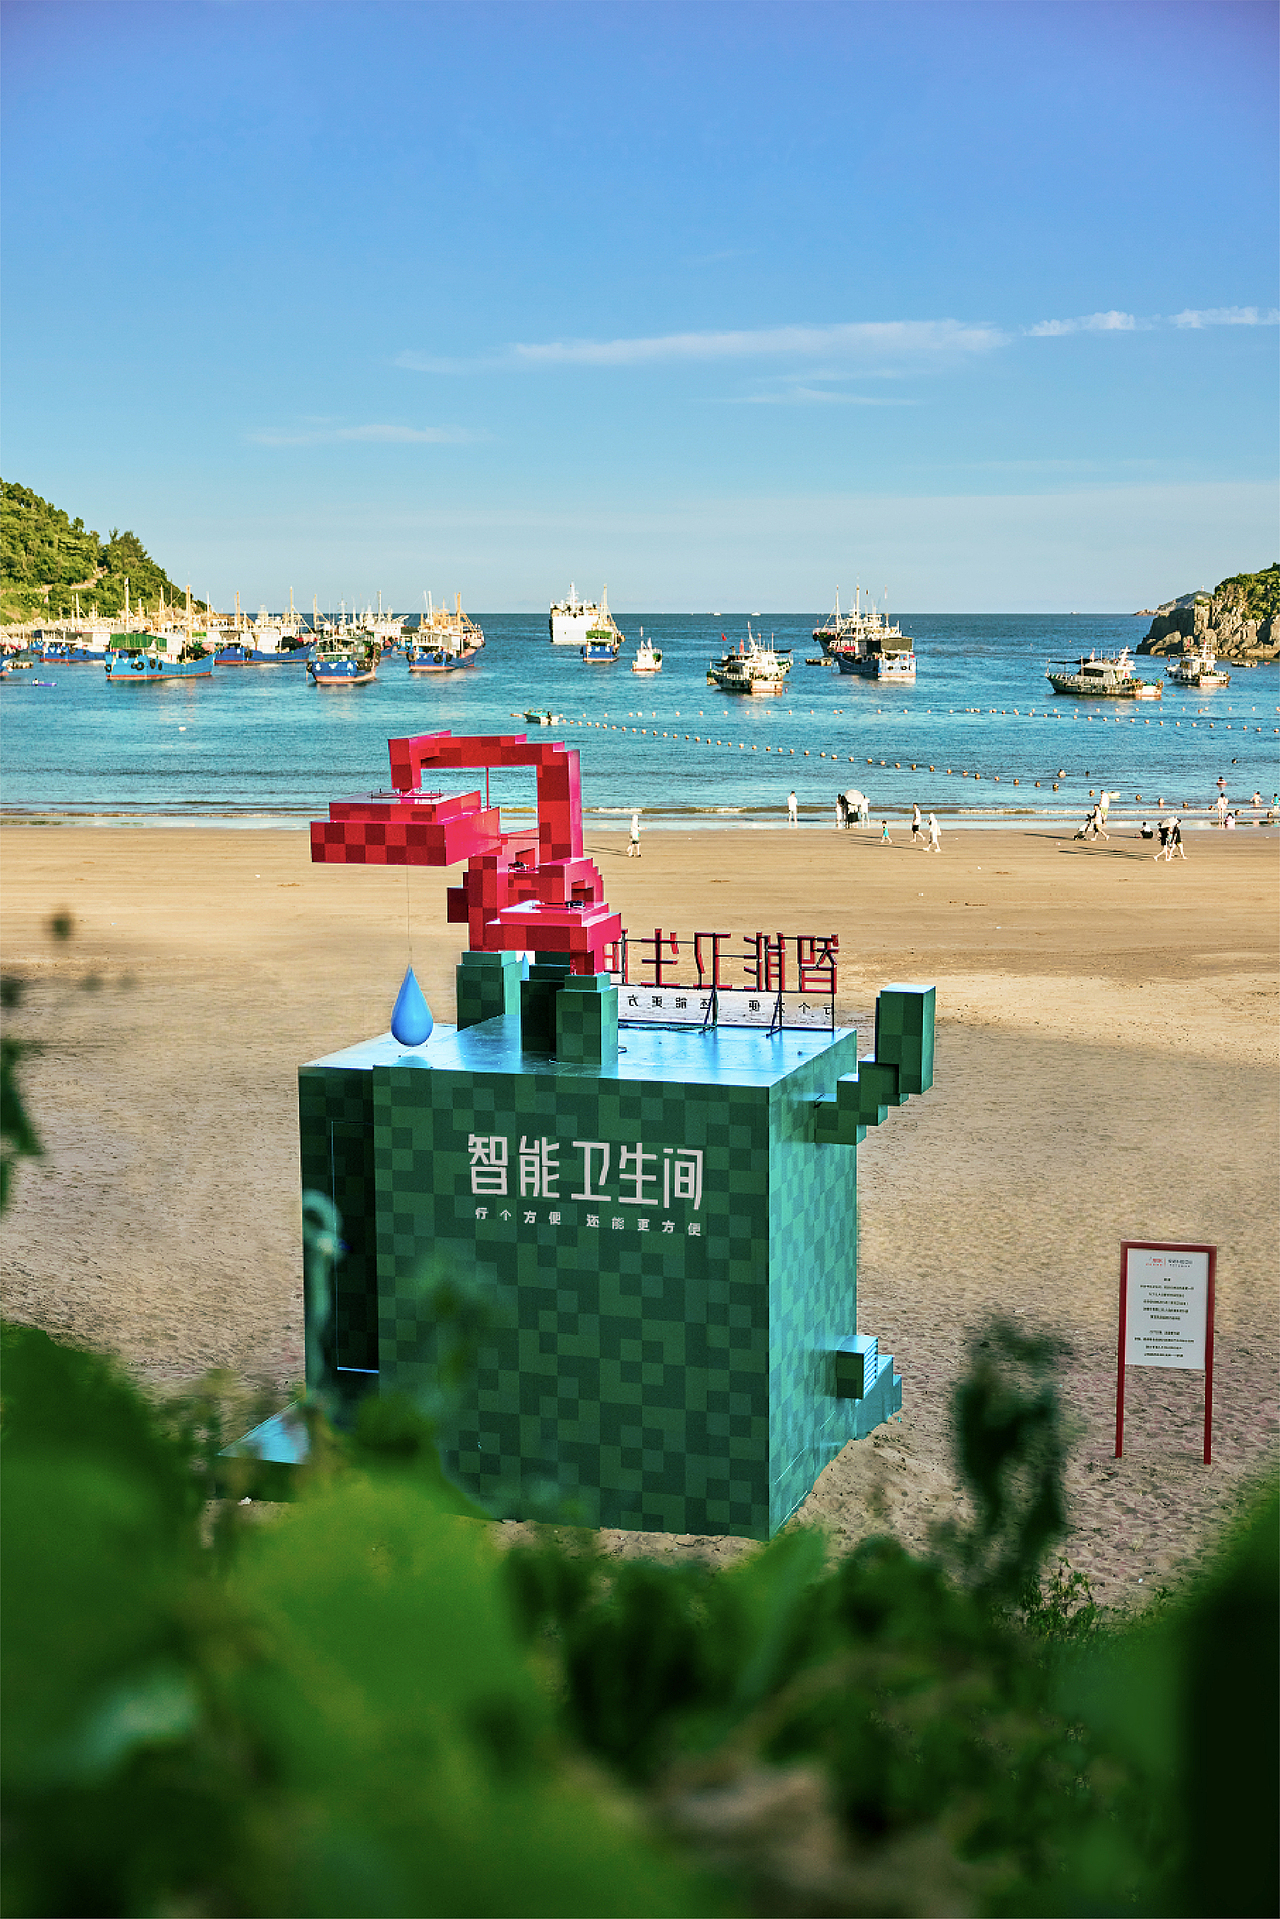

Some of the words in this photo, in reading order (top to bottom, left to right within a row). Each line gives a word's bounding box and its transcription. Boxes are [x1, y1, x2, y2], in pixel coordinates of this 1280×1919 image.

[467, 1133, 704, 1210] 智能卫生间
[475, 1207, 561, 1226] 行个方便
[586, 1213, 702, 1237] 还能更方便
